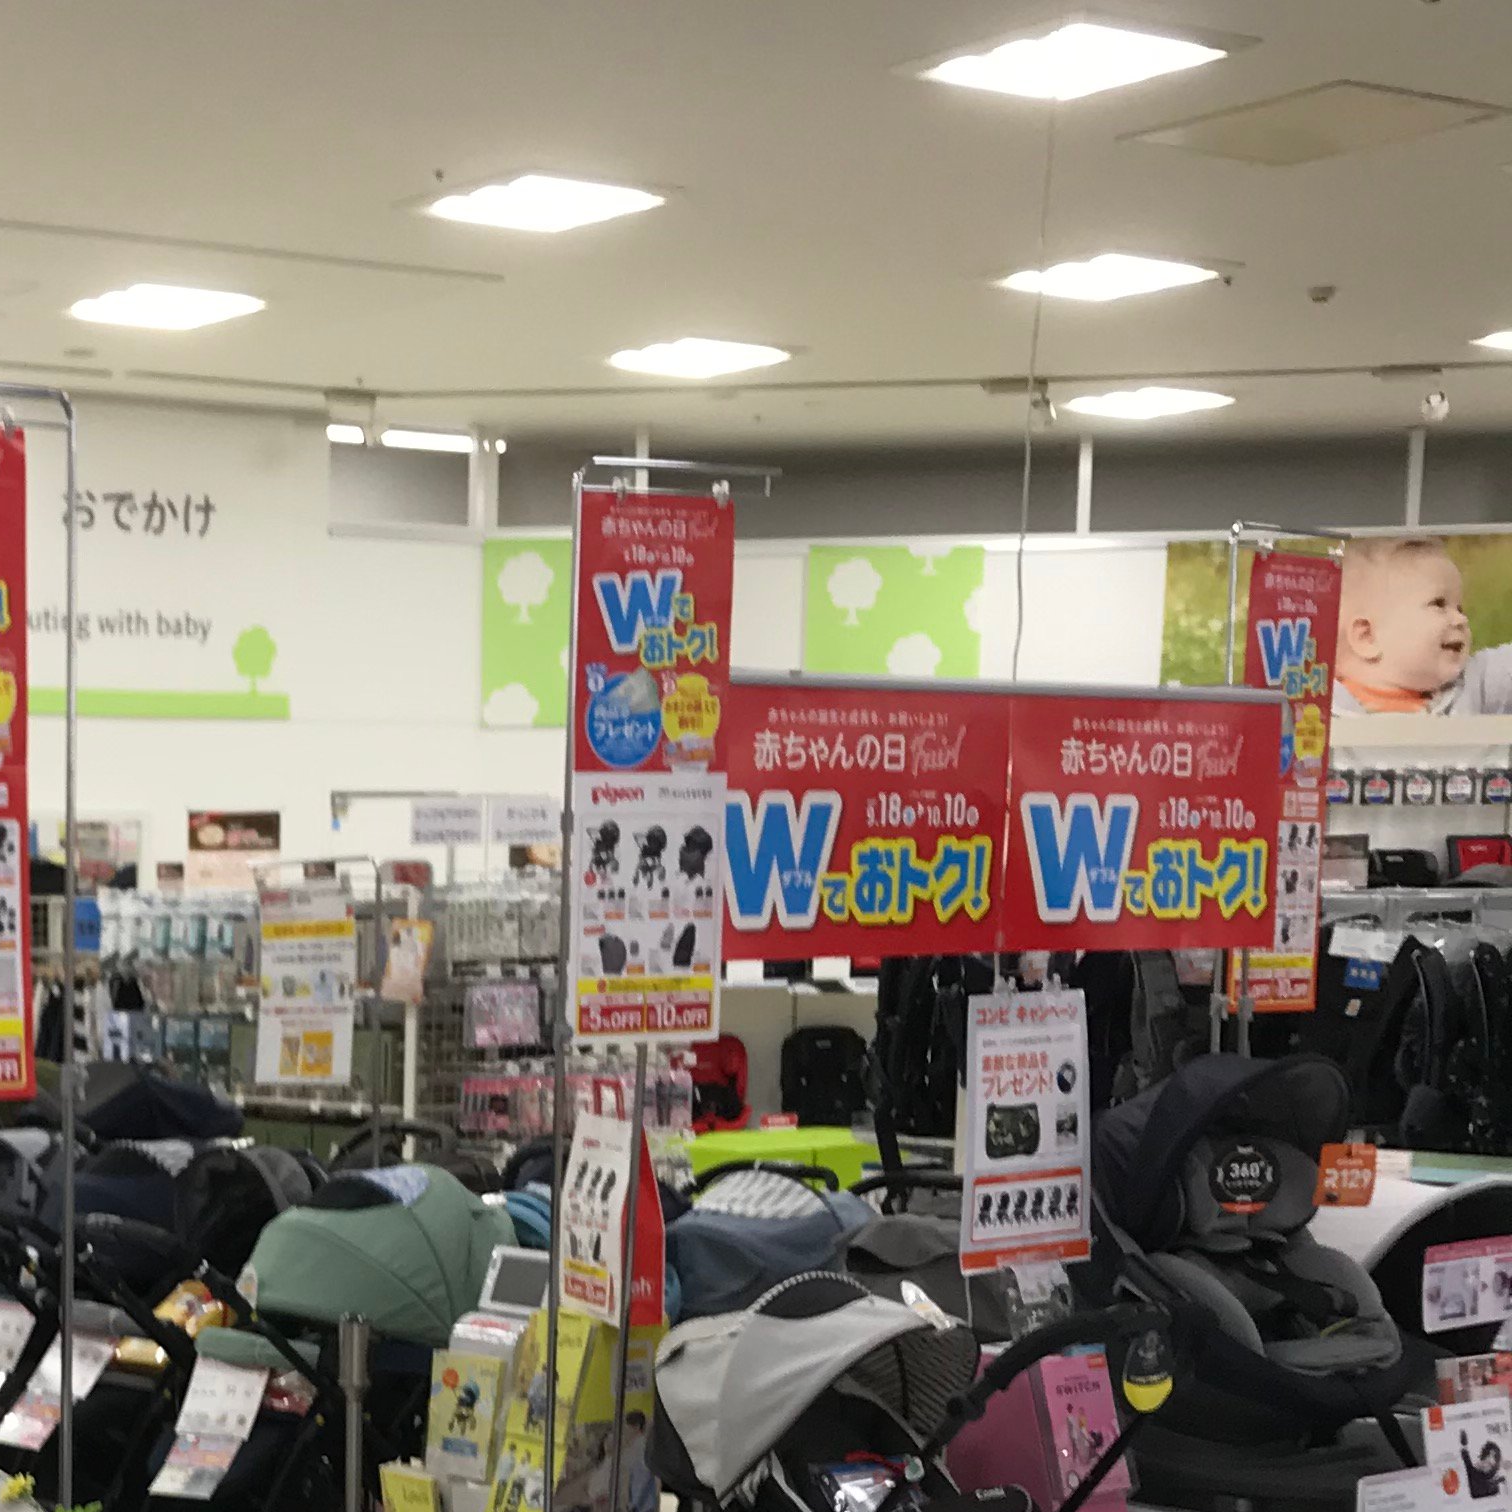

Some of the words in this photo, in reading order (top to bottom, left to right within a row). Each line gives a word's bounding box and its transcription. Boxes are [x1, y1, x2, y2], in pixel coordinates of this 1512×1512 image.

[63, 490, 216, 538] おでかけ
[28, 609, 90, 640] uting
[98, 609, 149, 638] with
[157, 611, 212, 645] baby
[754, 728, 905, 772] 赤ちゃんの日
[1061, 737, 1193, 778] 赤ちゃんの日
[1323, 1167, 1372, 1190] R129
